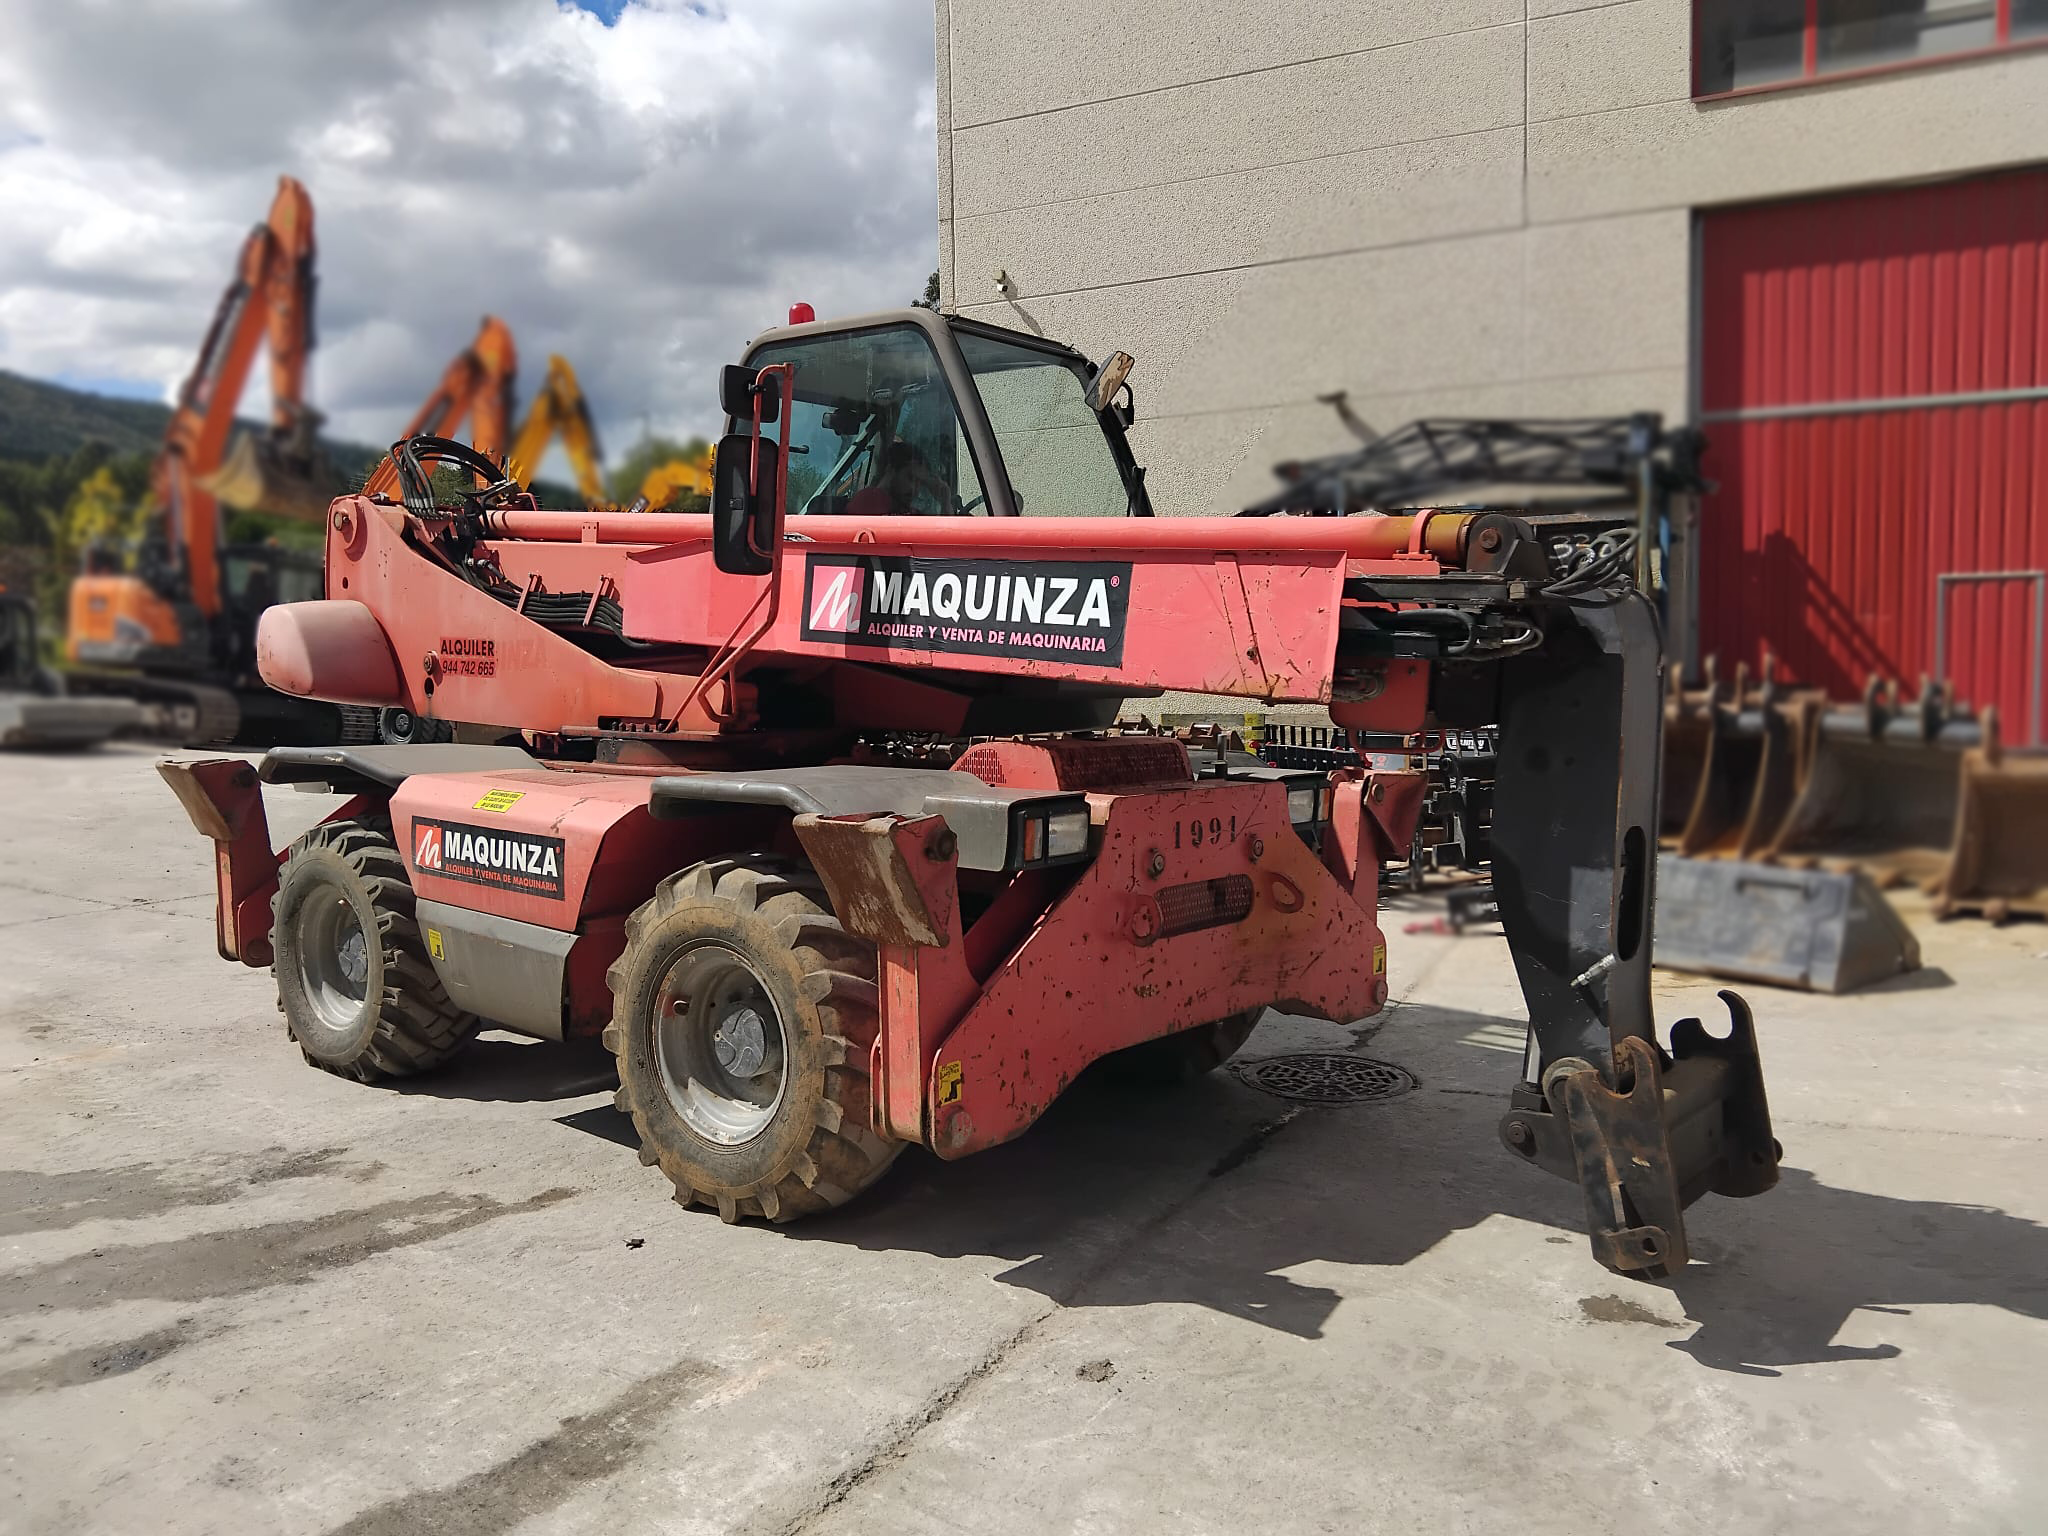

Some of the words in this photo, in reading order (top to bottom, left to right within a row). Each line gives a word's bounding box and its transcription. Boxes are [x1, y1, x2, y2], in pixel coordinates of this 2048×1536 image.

[440, 639, 495, 657] ALQUILER
[867, 622, 924, 638] ALQUILER
[929, 626, 938, 639] Y
[941, 627, 984, 643] VENTA
[988, 630, 1005, 645] DE
[1008, 632, 1107, 652] MAQUINARIA
[442, 660, 458, 674] 944
[460, 661, 476, 675] 742
[478, 661, 495, 676] 665
[1174, 816, 1236, 849] 1991
[445, 863, 473, 876] ALQUILER
[475, 868, 480, 878] Y
[481, 869, 501, 881] VENTA
[502, 873, 512, 884] DE
[512, 876, 558, 892] MAQUINARIA
